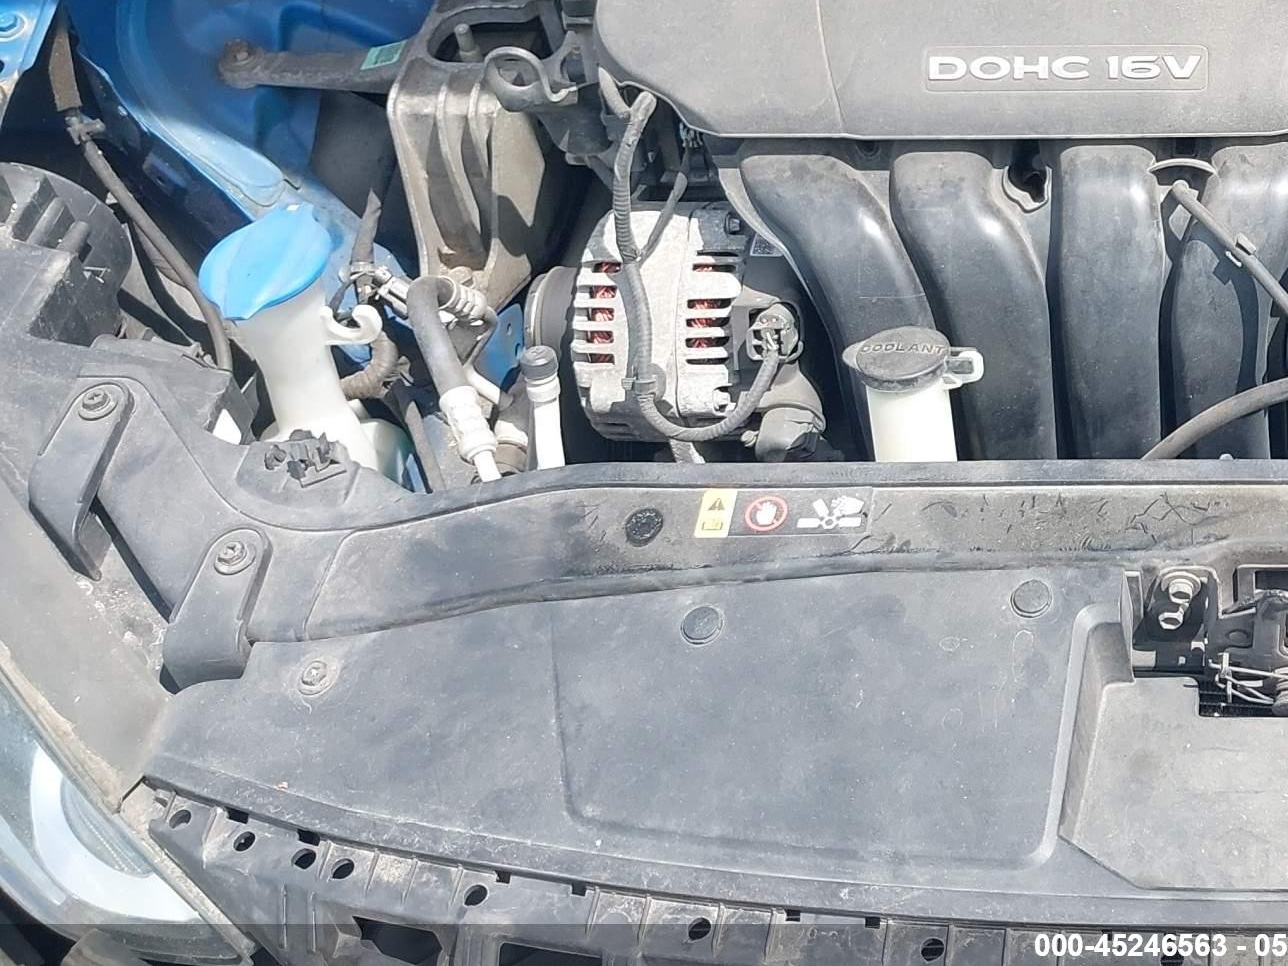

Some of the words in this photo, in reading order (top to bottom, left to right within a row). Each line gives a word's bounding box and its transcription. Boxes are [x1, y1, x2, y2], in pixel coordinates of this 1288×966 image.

[927, 56, 1090, 81] DOHC
[1106, 56, 1202, 80] 16V
[860, 342, 947, 356] COOLANT
